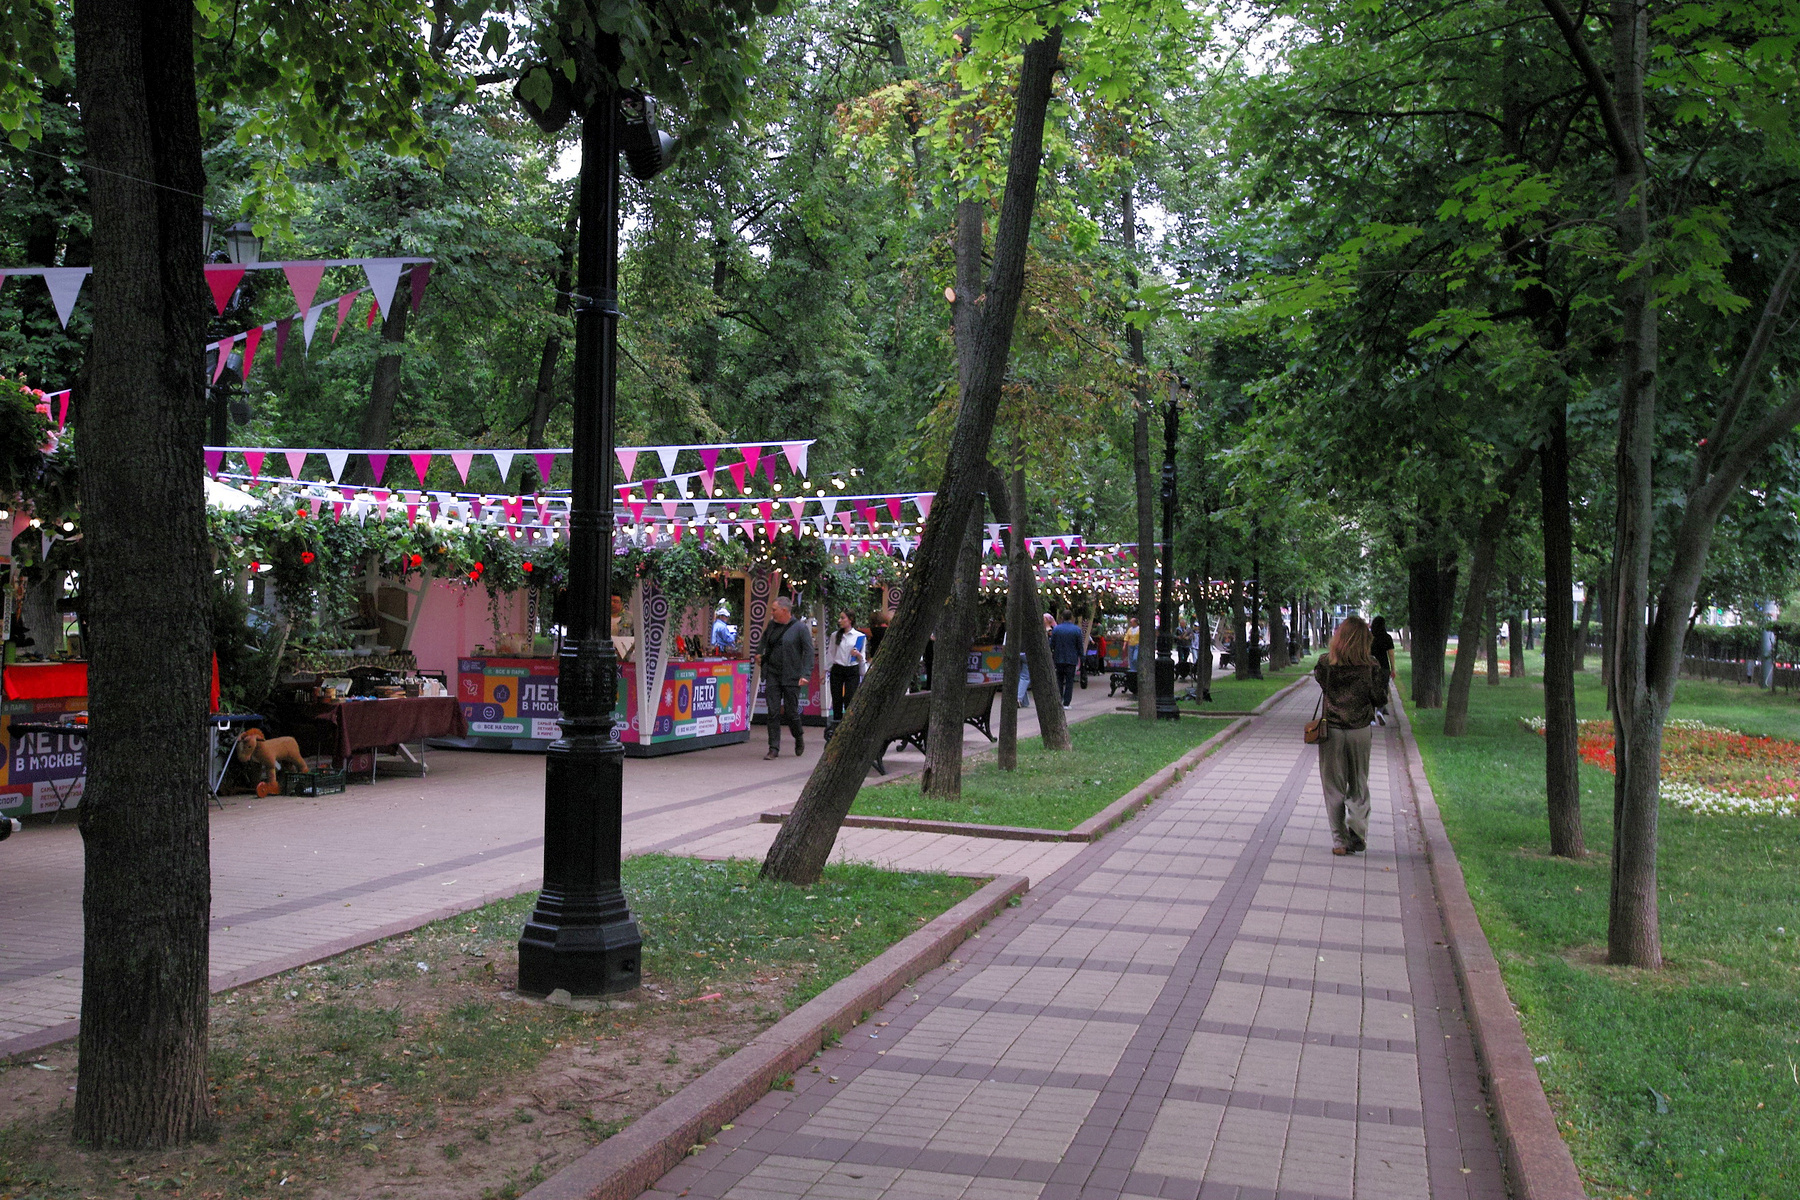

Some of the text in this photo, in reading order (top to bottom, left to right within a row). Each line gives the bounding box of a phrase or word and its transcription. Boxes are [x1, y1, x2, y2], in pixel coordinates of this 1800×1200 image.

[522, 684, 558, 702] ЛЕТ
[693, 685, 714, 702] ЛЕТО
[522, 701, 559, 712] В МОСК
[693, 702, 713, 711] В МОСКВЕ
[16, 753, 81, 771] В МОСКВЕ
